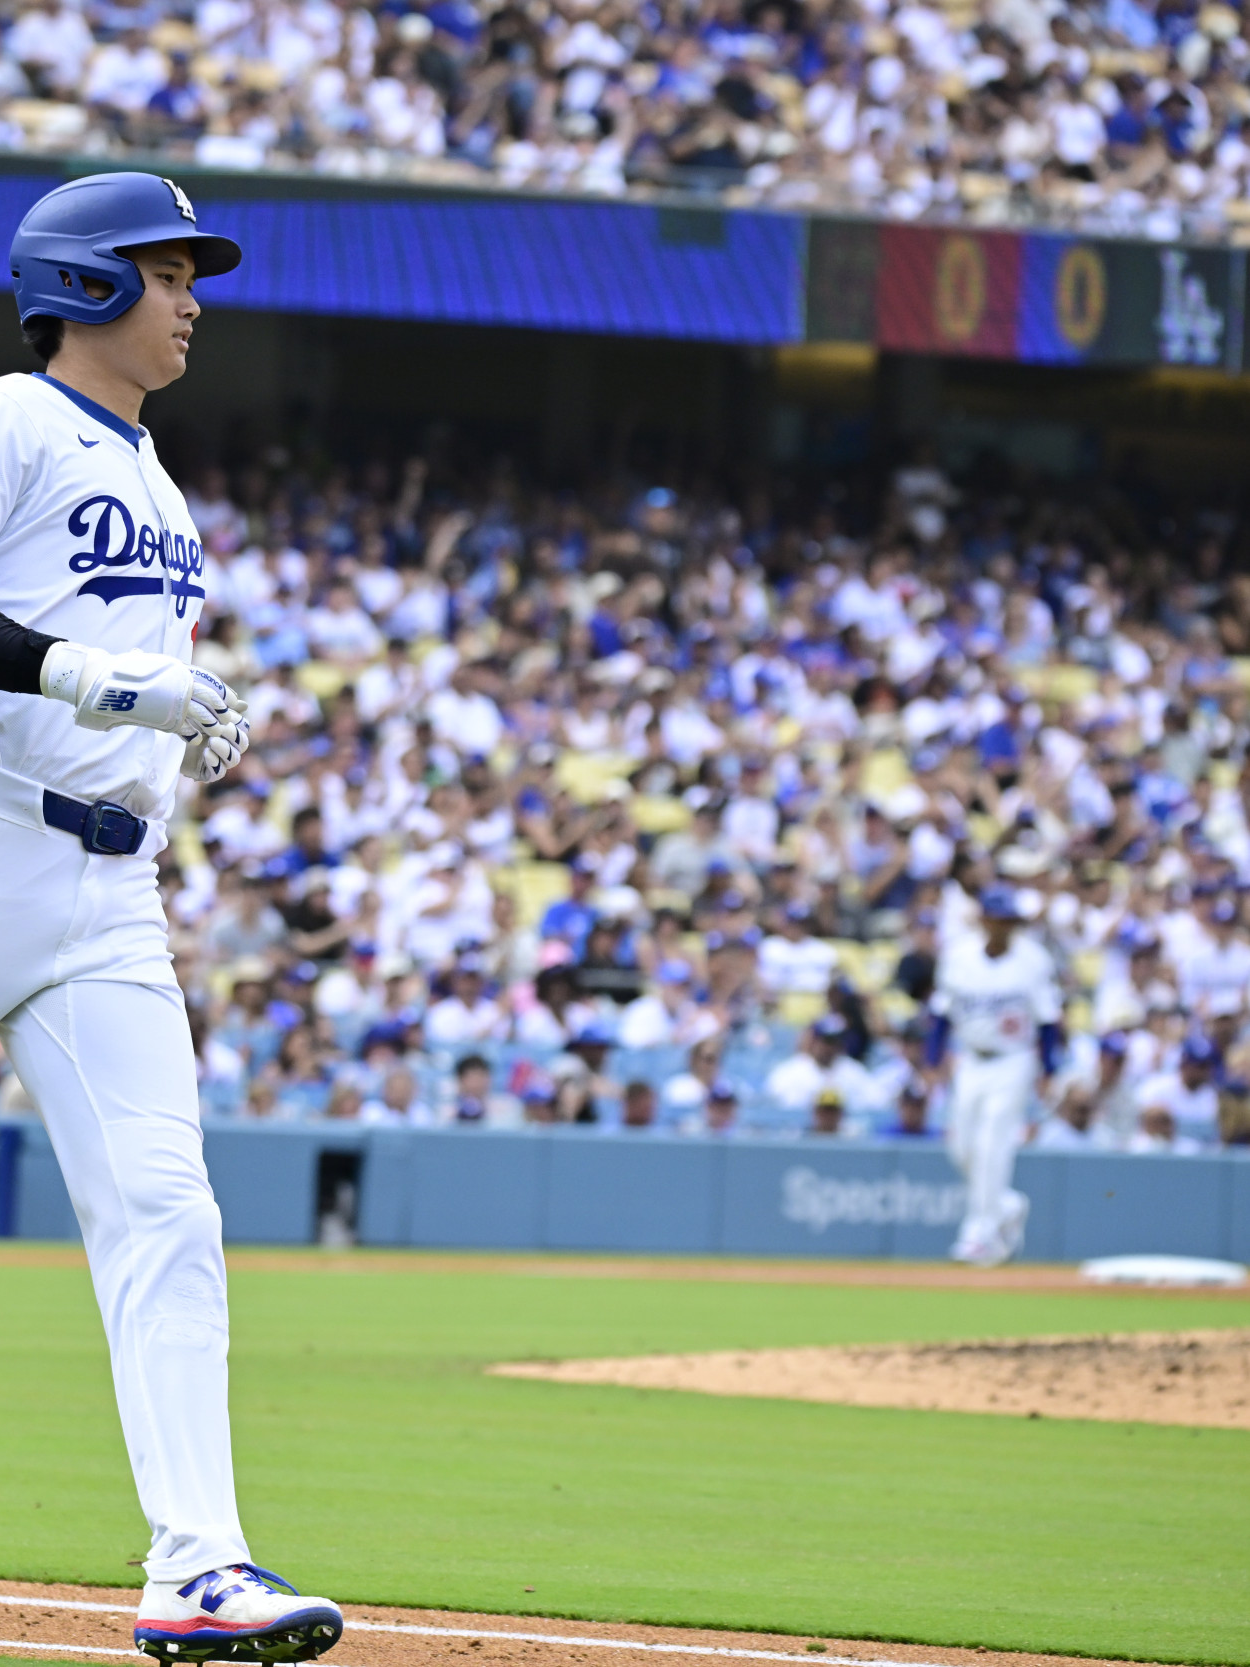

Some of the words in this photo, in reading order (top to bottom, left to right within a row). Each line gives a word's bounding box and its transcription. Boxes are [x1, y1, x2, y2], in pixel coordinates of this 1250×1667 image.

[936, 232, 986, 342] 0
[1055, 245, 1105, 348] 0
[1158, 249, 1223, 365] LA
[68, 495, 205, 619] Dodge
[195, 670, 222, 690] balance
